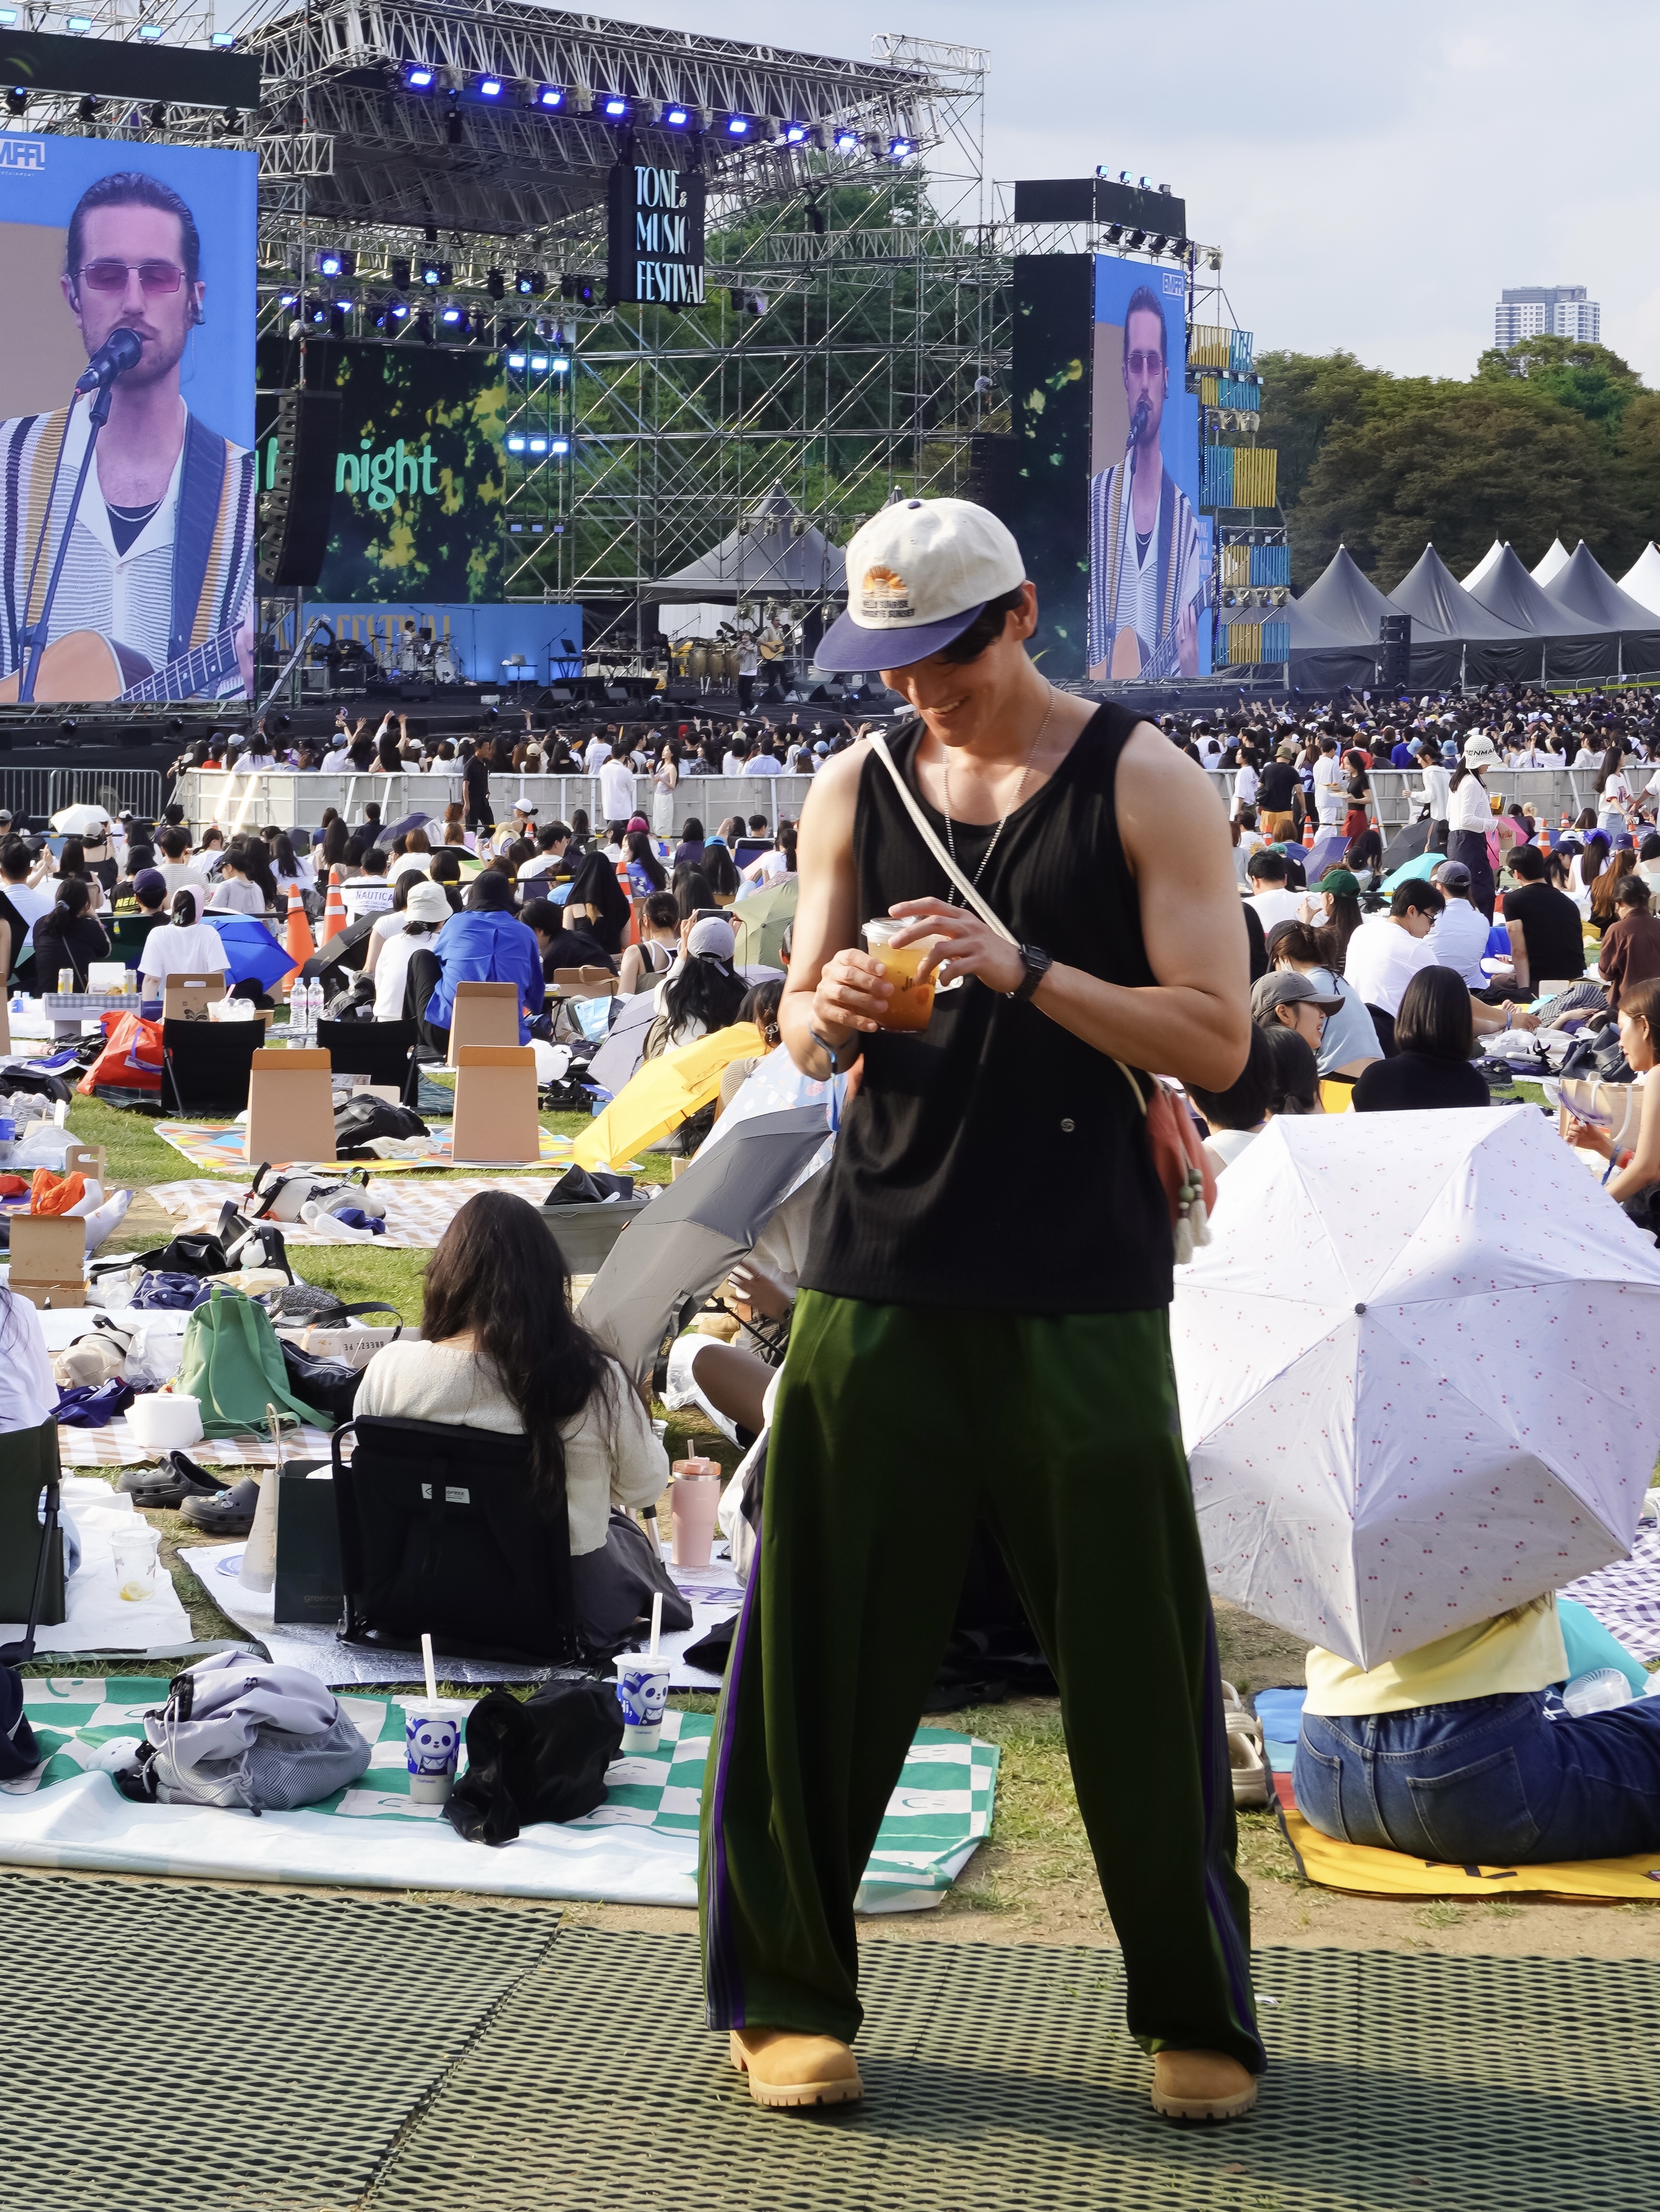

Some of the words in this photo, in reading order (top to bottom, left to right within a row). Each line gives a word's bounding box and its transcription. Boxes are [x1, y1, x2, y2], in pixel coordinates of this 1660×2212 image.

[637, 211, 691, 255] MUSIC
[637, 261, 707, 303] FESTIVAL
[335, 439, 438, 510] night
